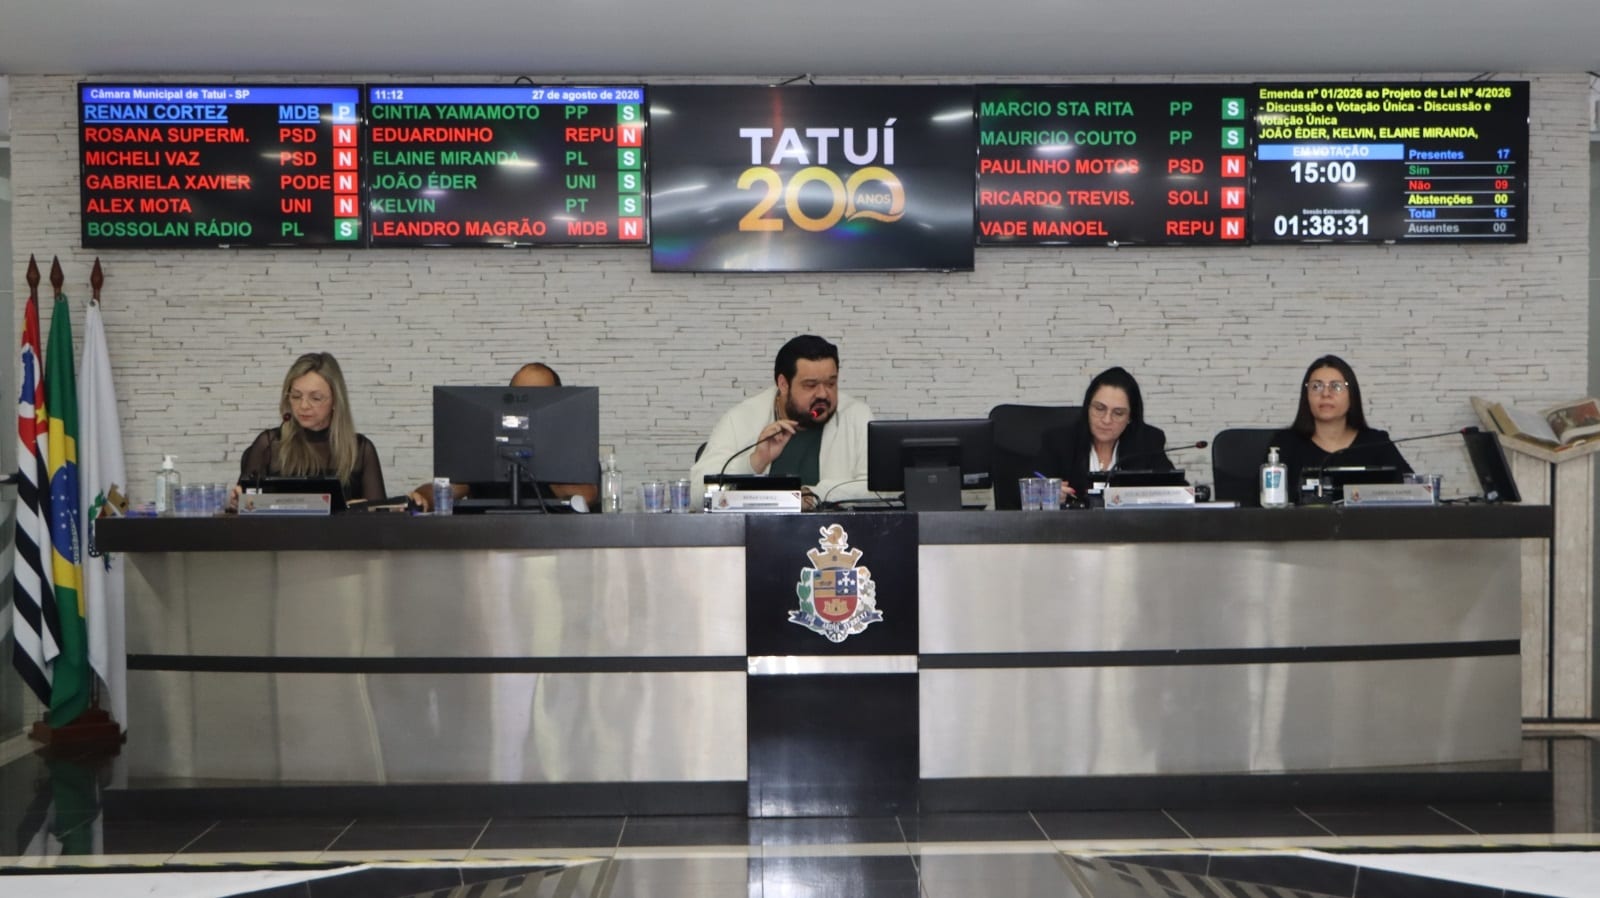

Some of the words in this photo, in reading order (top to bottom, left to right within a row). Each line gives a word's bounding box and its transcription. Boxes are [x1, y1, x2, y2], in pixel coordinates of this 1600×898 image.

[90, 89, 131, 99] Câmara
[133, 89, 183, 100] Municipal
[186, 89, 199, 99] de
[235, 89, 250, 99] SP
[375, 90, 403, 100] 11:12
[532, 90, 545, 100] 27
[547, 90, 560, 100] de
[562, 90, 597, 101] agosto
[600, 90, 613, 100] de
[615, 90, 640, 100] 2026
[1259, 89, 1304, 99] Emenda
[1321, 89, 1363, 99] 01/2026
[1365, 90, 1379, 99] ao
[1382, 89, 1421, 101] Projeto
[1424, 89, 1438, 98] de
[1441, 88, 1457, 98] Lei
[1475, 88, 1511, 98] 4/2026
[84, 106, 147, 119] RENAN
[153, 106, 227, 119] CORTEZ
[279, 106, 319, 119] MDB
[338, 107, 350, 118] P
[372, 106, 431, 120] CINTIA
[435, 106, 540, 120] YAMAMOTO
[565, 106, 588, 119] PP
[623, 107, 634, 120] S
[981, 102, 1051, 116] MARCIO
[1057, 102, 1090, 116] STA
[1096, 102, 1134, 116] RITA
[1170, 102, 1193, 116] PP
[1228, 103, 1238, 116] S
[1267, 101, 1324, 112] Discussão
[1327, 104, 1334, 112] e
[1336, 102, 1380, 114] Votação
[1383, 100, 1414, 112] Única
[1424, 101, 1481, 112] Discussão
[1259, 116, 1303, 128] Votação
[1306, 113, 1337, 126] Única
[85, 128, 162, 143] ROSANA
[167, 128, 250, 143] SUPERM.
[280, 129, 316, 143] PSD
[339, 130, 351, 143] N
[372, 128, 493, 142] EDUARDINHO
[565, 128, 614, 142] REPU
[624, 130, 635, 143] N
[981, 131, 1068, 146] MAURICIO
[1075, 131, 1137, 145] COUTO
[1170, 131, 1192, 145] PP
[1228, 132, 1238, 145] S
[1259, 127, 1292, 139] JOÃO
[1295, 126, 1330, 141] ÉDER,
[1333, 128, 1377, 141] KELVIN,
[1380, 128, 1420, 138] ELAINE
[1423, 128, 1478, 140] MIRANDA,
[739, 118, 897, 165] TATUÍ
[86, 152, 160, 166] MICHELI
[165, 152, 200, 166] VAZ
[280, 152, 317, 166] PSD
[339, 153, 351, 166] N
[373, 152, 435, 165] ELAINE
[441, 152, 520, 165] MIRANDA
[566, 152, 588, 166] PL
[624, 152, 635, 166] S
[1409, 150, 1464, 160] Presentes
[1497, 150, 1510, 159] 17
[981, 159, 1070, 175] PAULINHO
[1075, 159, 1139, 174] MOTOS
[1168, 159, 1204, 174] PSD
[1227, 160, 1239, 173] N
[1290, 162, 1356, 183] 15:00
[1409, 165, 1430, 175] Sim
[1496, 166, 1509, 175] 07
[87, 175, 180, 190] GABRIELA
[185, 175, 251, 190] XAVIER
[281, 176, 330, 190] PODE
[340, 176, 352, 190] N
[373, 174, 422, 190] JOÃO
[428, 172, 477, 190] ÉDER
[566, 175, 595, 189] UNI
[624, 175, 635, 189] S
[1409, 180, 1431, 190] Não
[1495, 180, 1508, 190] 09
[736, 166, 905, 233] 200
[856, 194, 891, 205] ANOS
[981, 191, 1061, 206] RICARDO
[1067, 191, 1134, 205] TREVIS.
[1168, 191, 1208, 205] SOLI
[1227, 192, 1239, 204] N
[1408, 194, 1473, 206] Abstenções
[1495, 194, 1508, 204] 00
[87, 199, 134, 213] ALEX
[141, 199, 192, 213] MOTA
[281, 199, 311, 213] UNI
[340, 200, 352, 213] N
[372, 199, 435, 213] KELVIN
[566, 199, 588, 213] PT
[624, 199, 635, 213] S
[1408, 209, 1436, 218] Total
[1494, 209, 1508, 218] 16
[88, 222, 189, 237] BOSSOLAN
[195, 219, 252, 237] RÁDIO
[282, 224, 304, 237] PL
[340, 223, 352, 237] S
[372, 222, 460, 236] LEANDRO
[466, 219, 546, 236] MAGRÃO
[568, 222, 607, 236] MDB
[625, 223, 636, 236] N
[981, 221, 1027, 236] VADE
[1033, 221, 1108, 235] MANOEL
[1166, 221, 1214, 235] REPU
[1227, 221, 1239, 234] N
[1274, 215, 1369, 236] 01:38:31
[1408, 223, 1459, 233] Ausentes
[1493, 223, 1506, 232] 00
